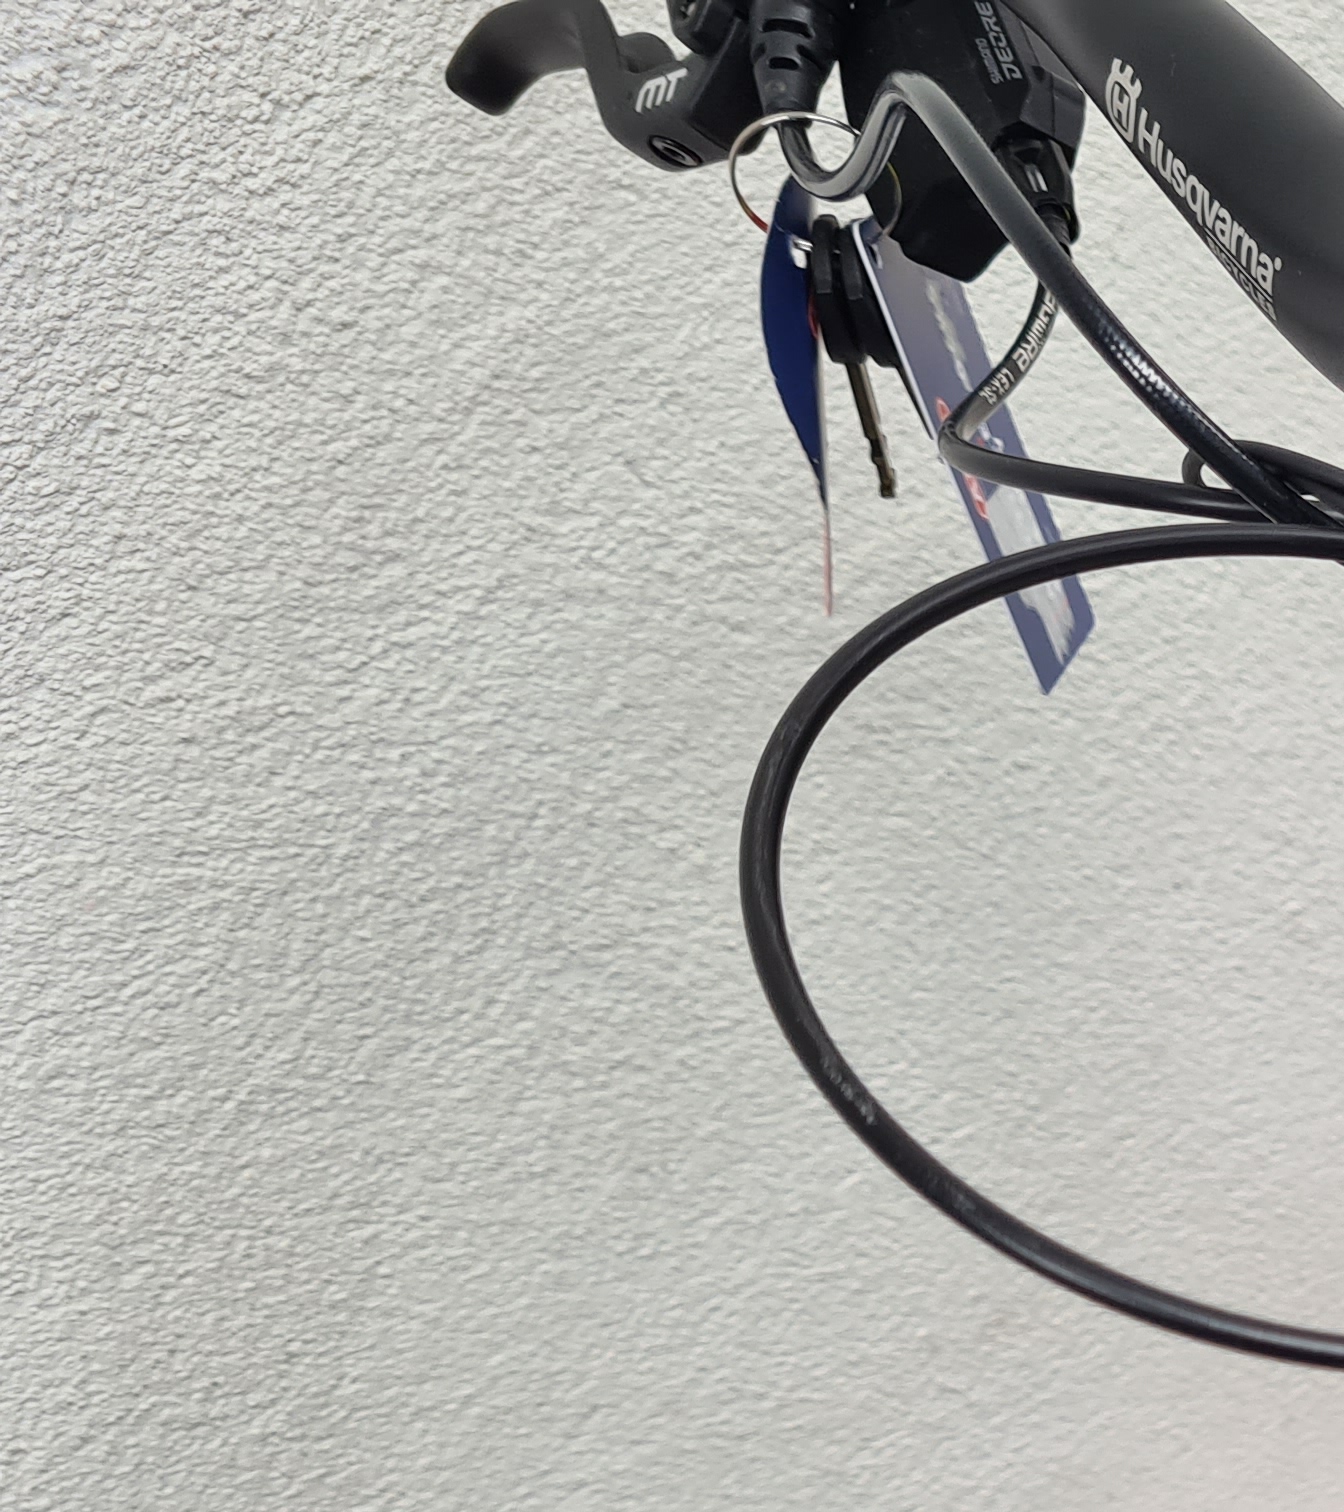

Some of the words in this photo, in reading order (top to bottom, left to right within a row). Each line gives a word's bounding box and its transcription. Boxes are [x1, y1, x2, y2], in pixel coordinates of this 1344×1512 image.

[974, 0, 1023, 80] DEORE
[634, 67, 688, 113] MT
[1138, 106, 1282, 297] Husqvarna
